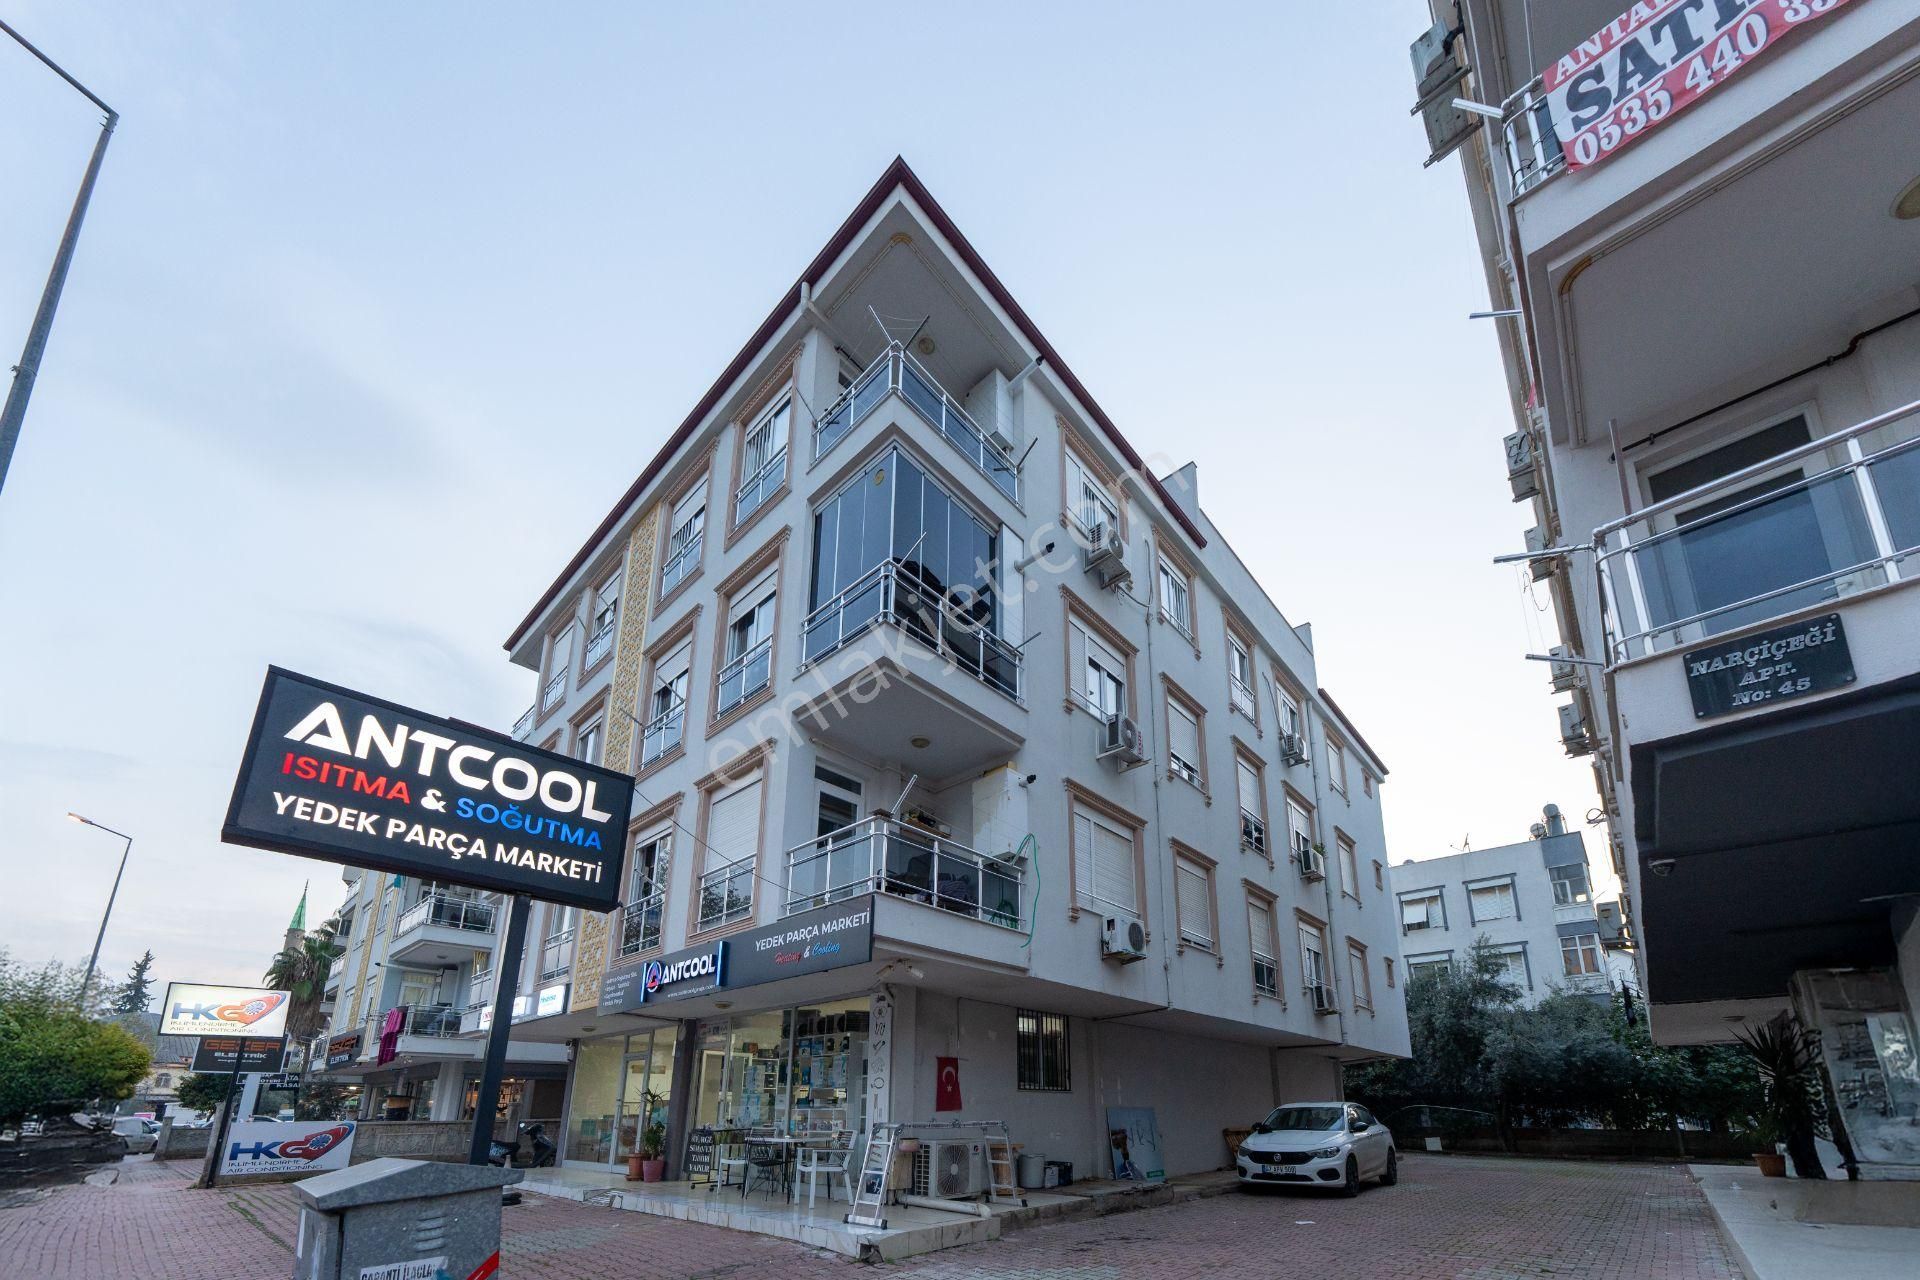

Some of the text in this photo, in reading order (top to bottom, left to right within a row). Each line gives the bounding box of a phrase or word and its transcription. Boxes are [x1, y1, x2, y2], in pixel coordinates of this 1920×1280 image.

[1574, 78, 1673, 166] 0535
[1685, 14, 1770, 94] 440
[1690, 623, 1836, 677] NARÇİÇEĞİ
[1739, 662, 1797, 686] APT.
[1732, 677, 1811, 706] No: 45
[284, 702, 612, 823] ANTCOOL
[282, 752, 602, 851] ISITMA & SOĞUTMA
[273, 791, 602, 884] YEDEK PARÇA MARKETİ
[756, 907, 870, 951] YEDEK PARÇA MARKETİ
[803, 946, 811, 958] &
[661, 954, 716, 984] ANTCOOL
